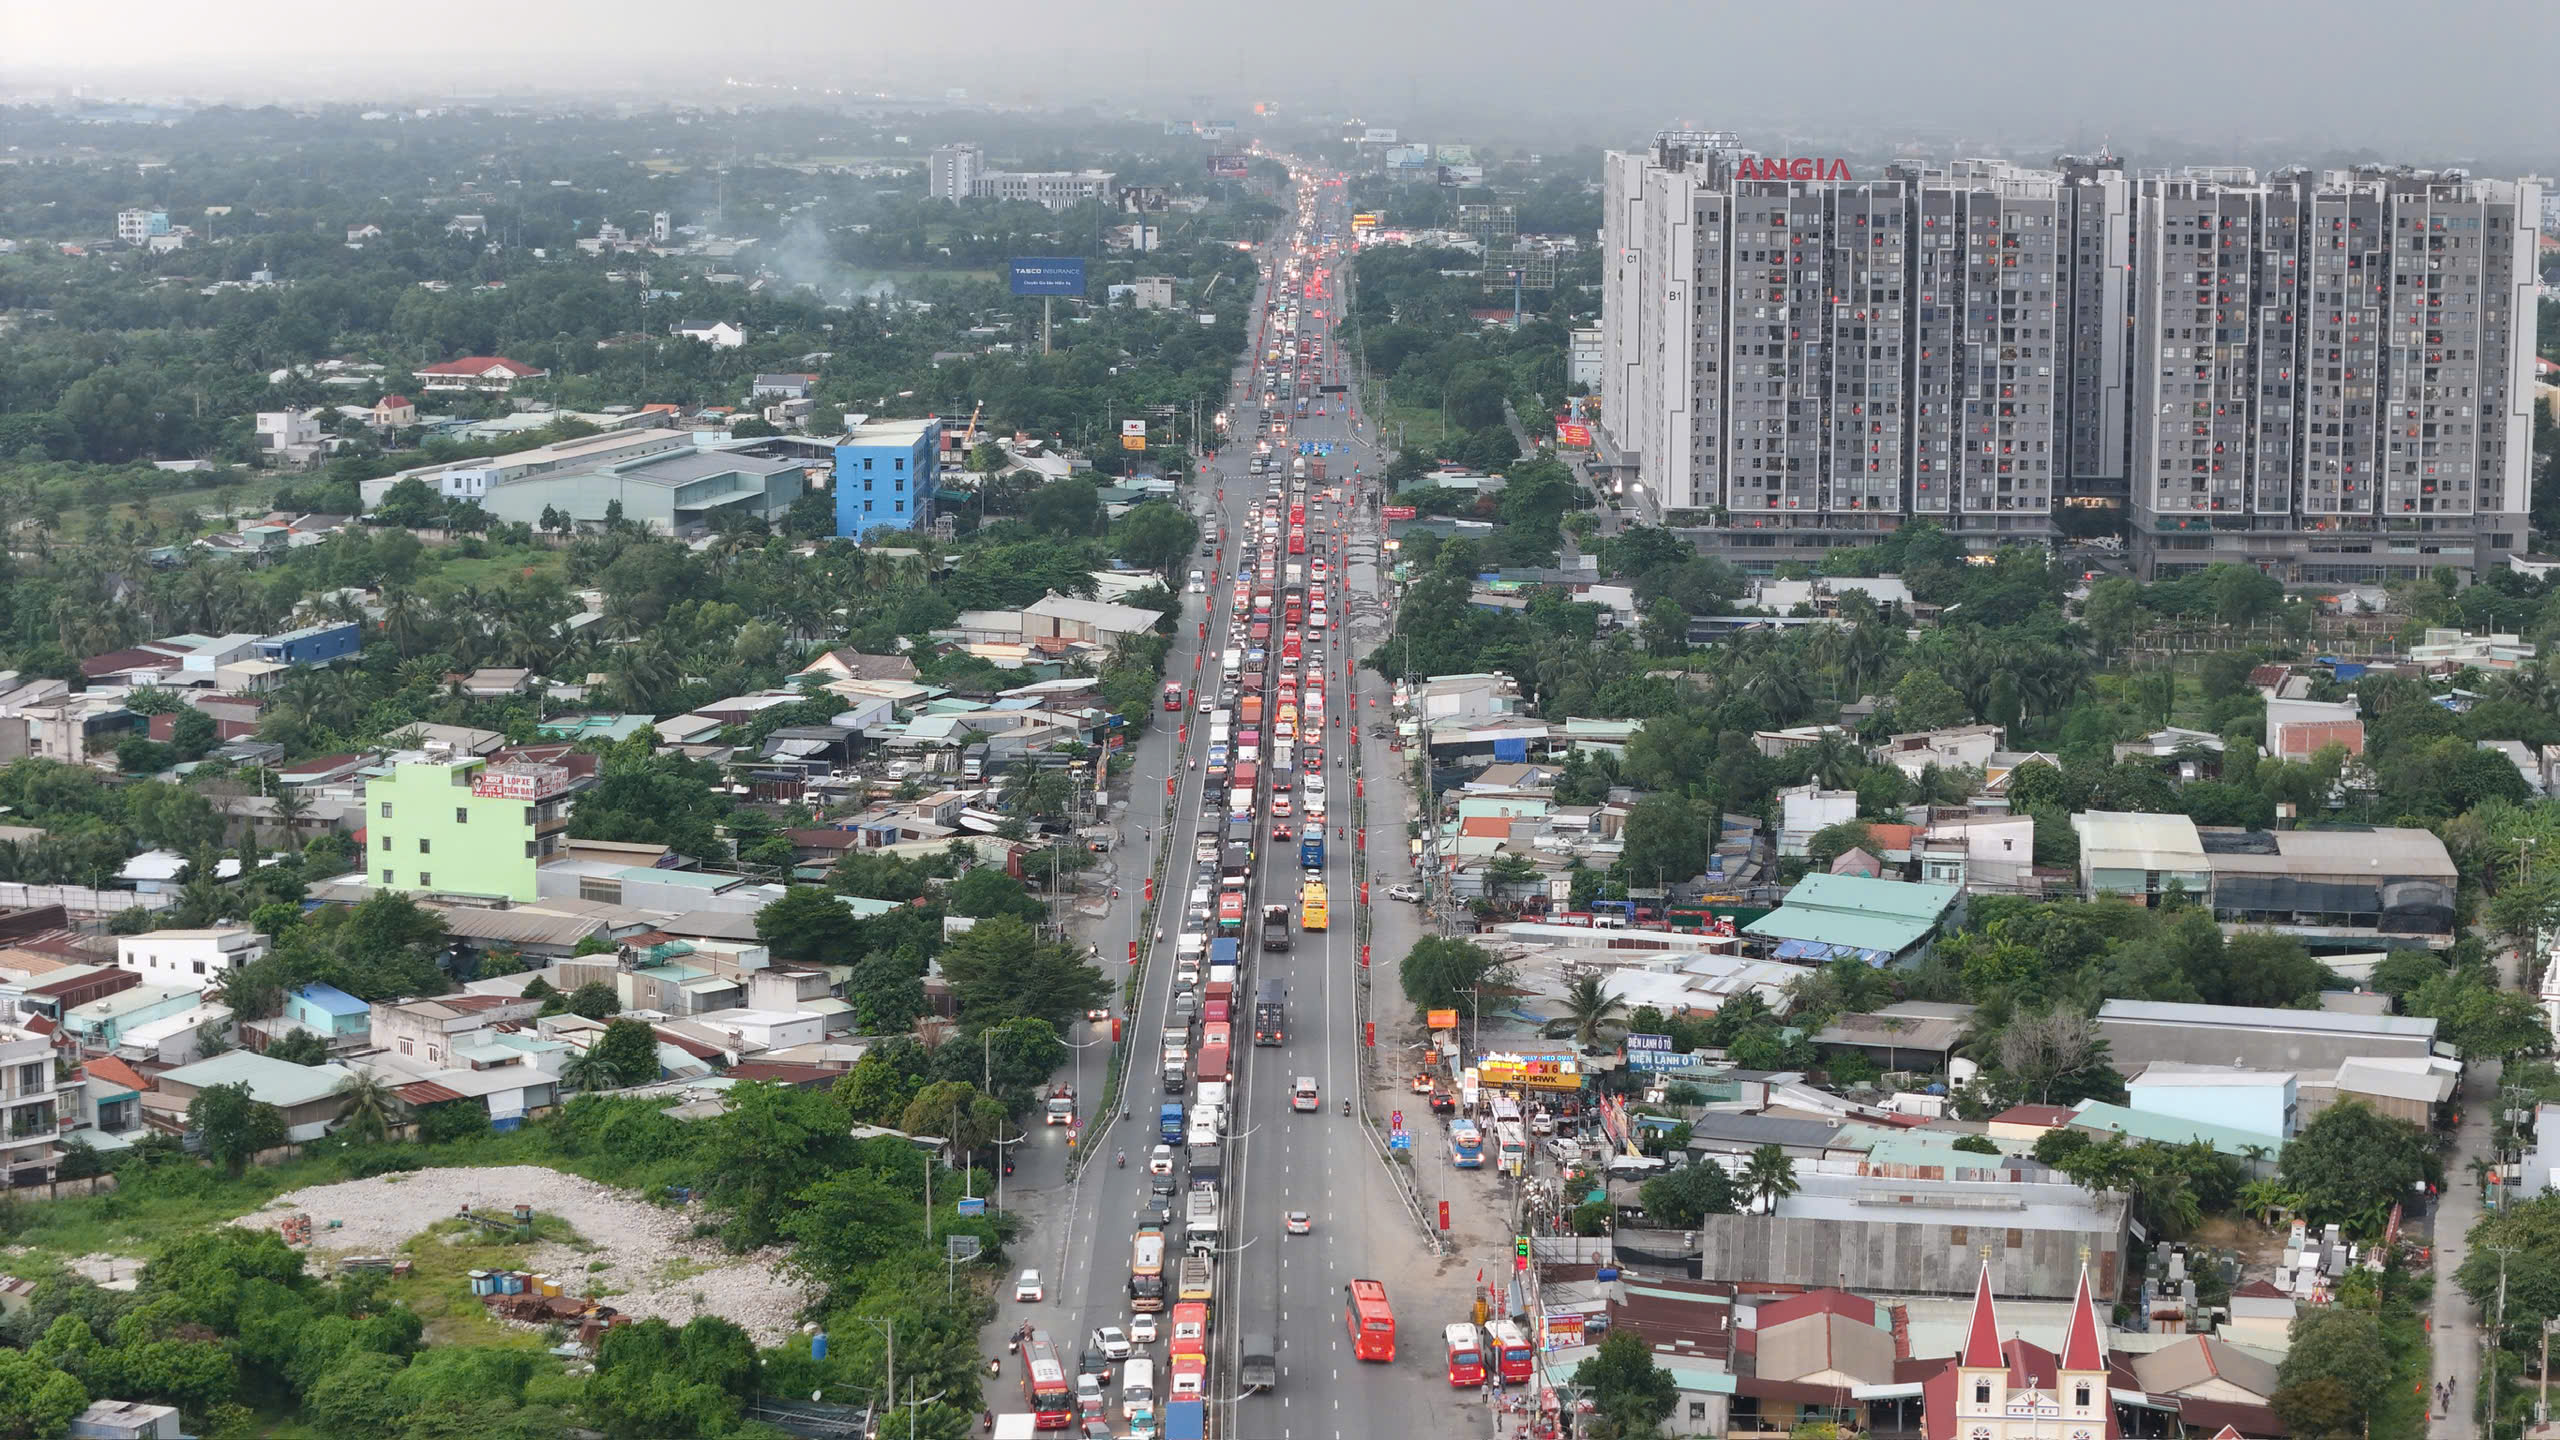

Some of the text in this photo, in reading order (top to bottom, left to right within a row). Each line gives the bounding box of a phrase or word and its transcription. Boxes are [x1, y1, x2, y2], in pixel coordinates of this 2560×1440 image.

[1735, 157, 1852, 181] ANGIA
[1627, 255, 1637, 264] C1
[1669, 291, 1681, 301] B1
[1628, 1036, 1642, 1050] ĐIỆN
[1658, 1037, 1662, 1049] Ô
[1630, 1052, 1652, 1064] ĐIỆN
[1529, 1075, 1557, 1083] HAWK
